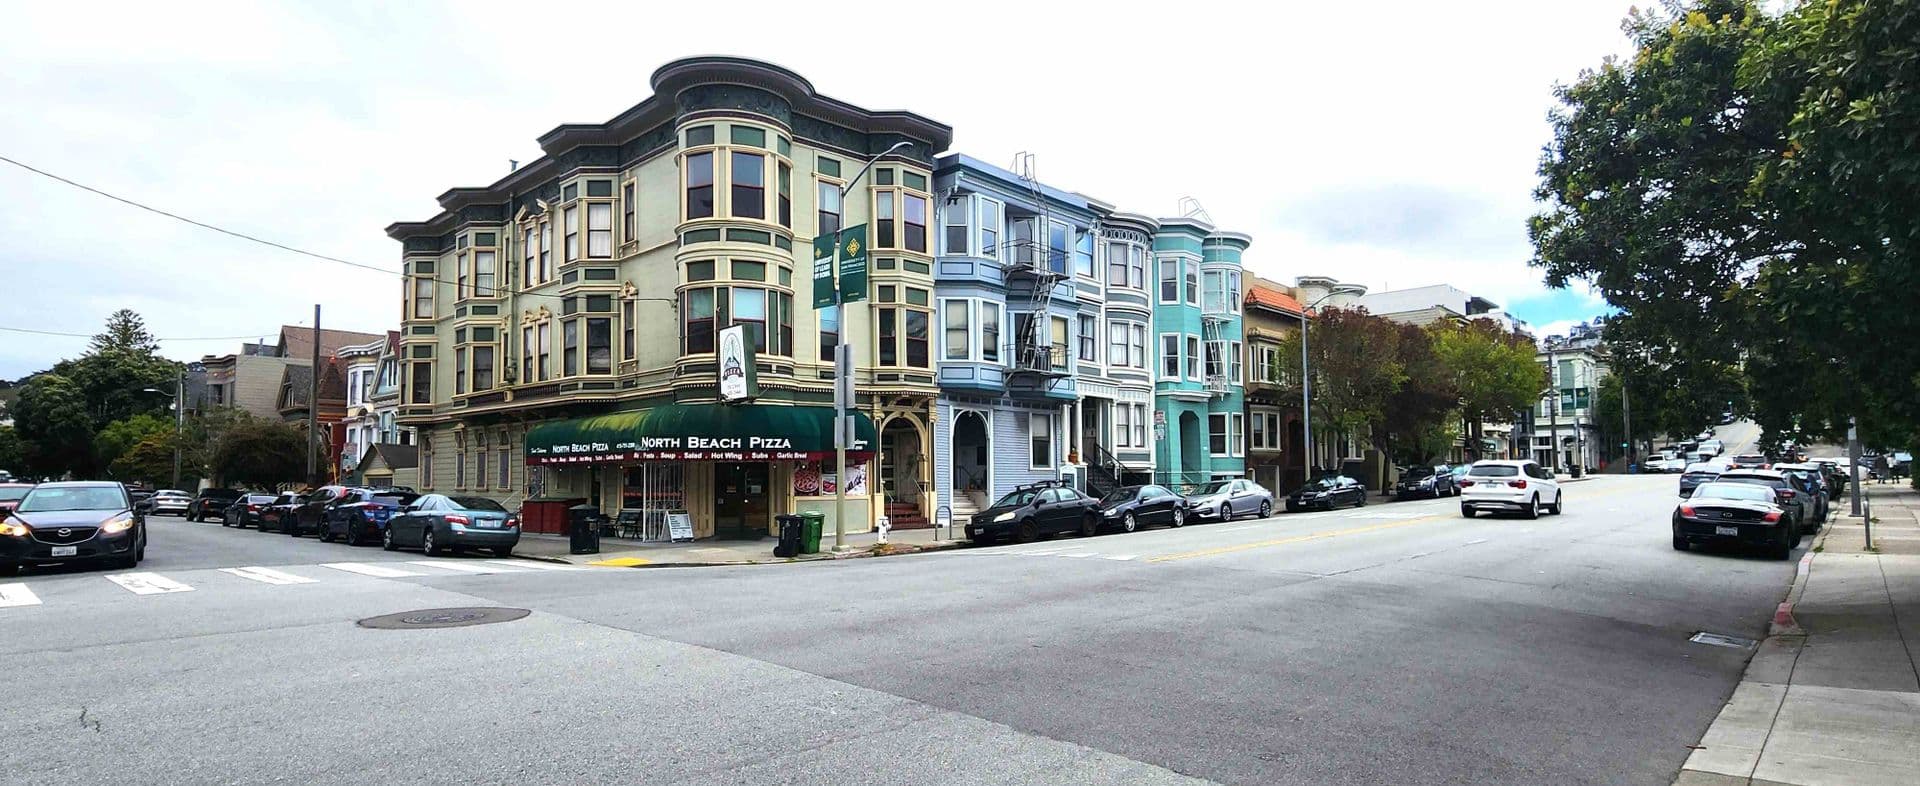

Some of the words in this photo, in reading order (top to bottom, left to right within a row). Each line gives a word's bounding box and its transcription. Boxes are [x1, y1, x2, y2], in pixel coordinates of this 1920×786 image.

[552, 445, 569, 453] NORTH
[571, 443, 590, 453] BEACH
[592, 442, 608, 451] PIZZA
[641, 437, 680, 448] NORTH
[688, 437, 741, 448] BEACH
[750, 437, 791, 448] PIZZA
[660, 452, 676, 461] Soup
[725, 452, 742, 460] Wing
